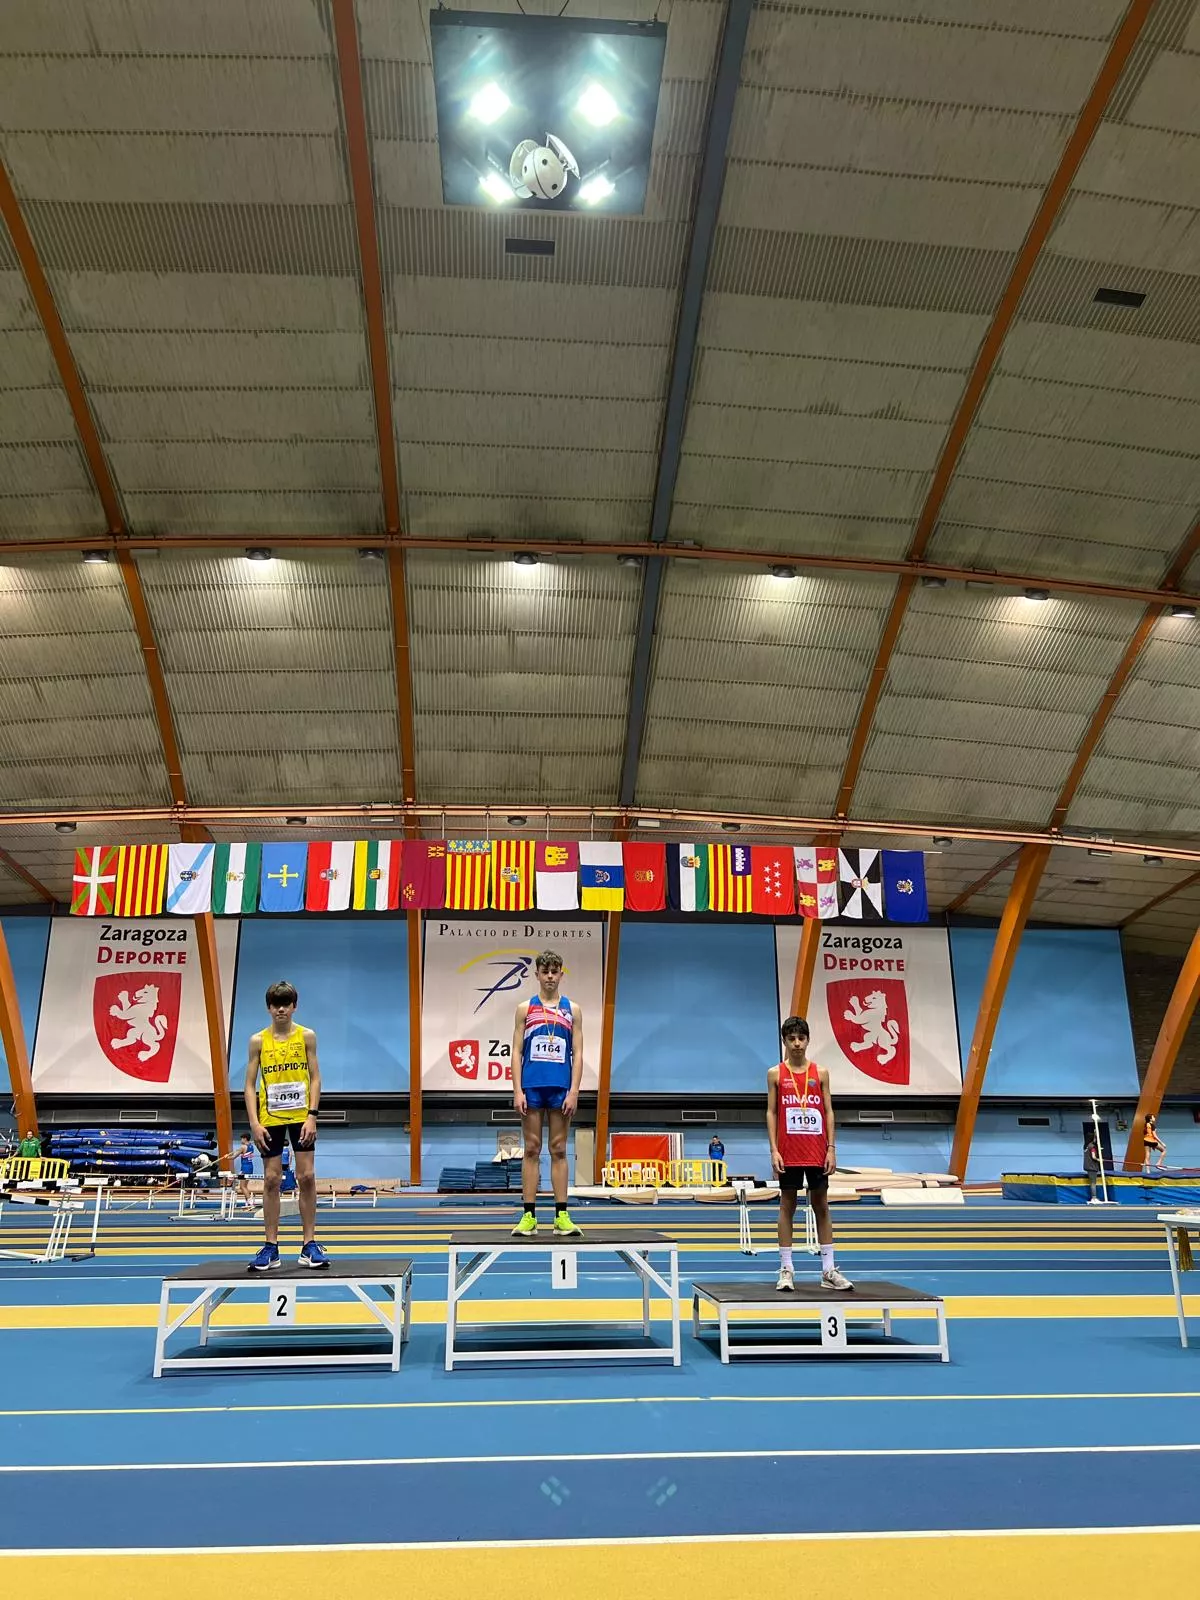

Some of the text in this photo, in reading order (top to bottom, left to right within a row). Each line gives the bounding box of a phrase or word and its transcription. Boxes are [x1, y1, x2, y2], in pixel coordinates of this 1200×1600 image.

[100, 925, 187, 946] Zaragoza
[439, 923, 592, 938] PALACIO DE DEPORTES
[822, 933, 903, 954] Zaragoza
[97, 946, 187, 965] DEPORTE
[823, 953, 905, 972] DEPORTE
[536, 1043, 561, 1053] 1164
[790, 1116, 817, 1125] 1109
[560, 1258, 566, 1280] 1
[276, 1294, 288, 1317] 2
[827, 1316, 838, 1338] 3
